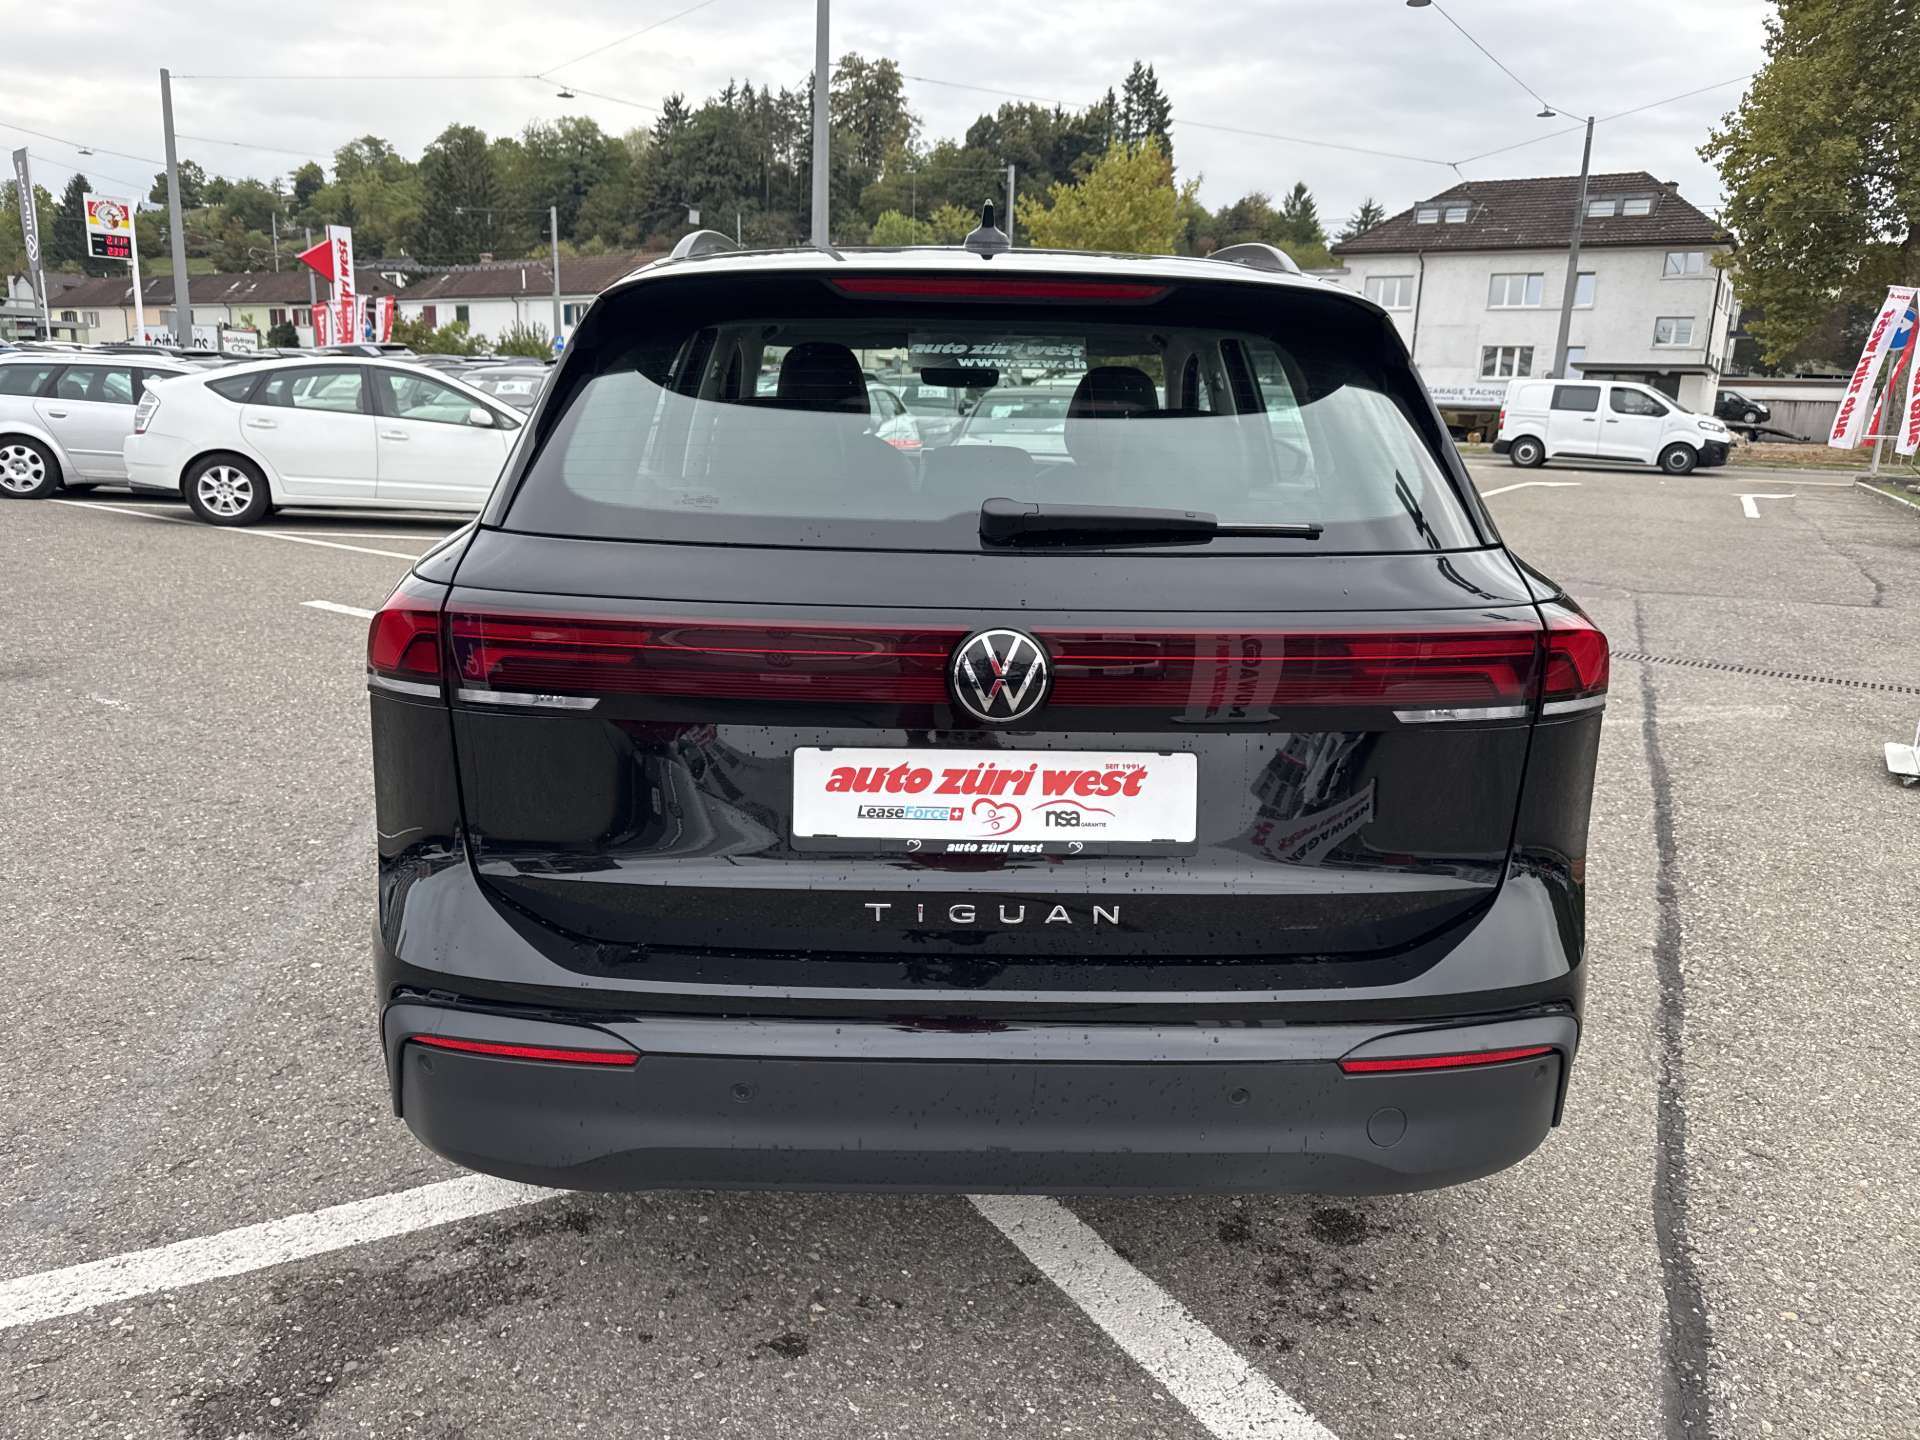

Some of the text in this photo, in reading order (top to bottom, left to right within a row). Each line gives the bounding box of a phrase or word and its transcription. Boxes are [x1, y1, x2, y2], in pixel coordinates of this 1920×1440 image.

[910, 343, 967, 354] auto
[1026, 344, 1083, 356] west
[826, 761, 1148, 797] auto züri west
[857, 805, 950, 819] LeaseForce
[1045, 811, 1080, 828] nsa
[946, 843, 1044, 853] auto züri west
[865, 903, 1120, 925] TIGUAN
